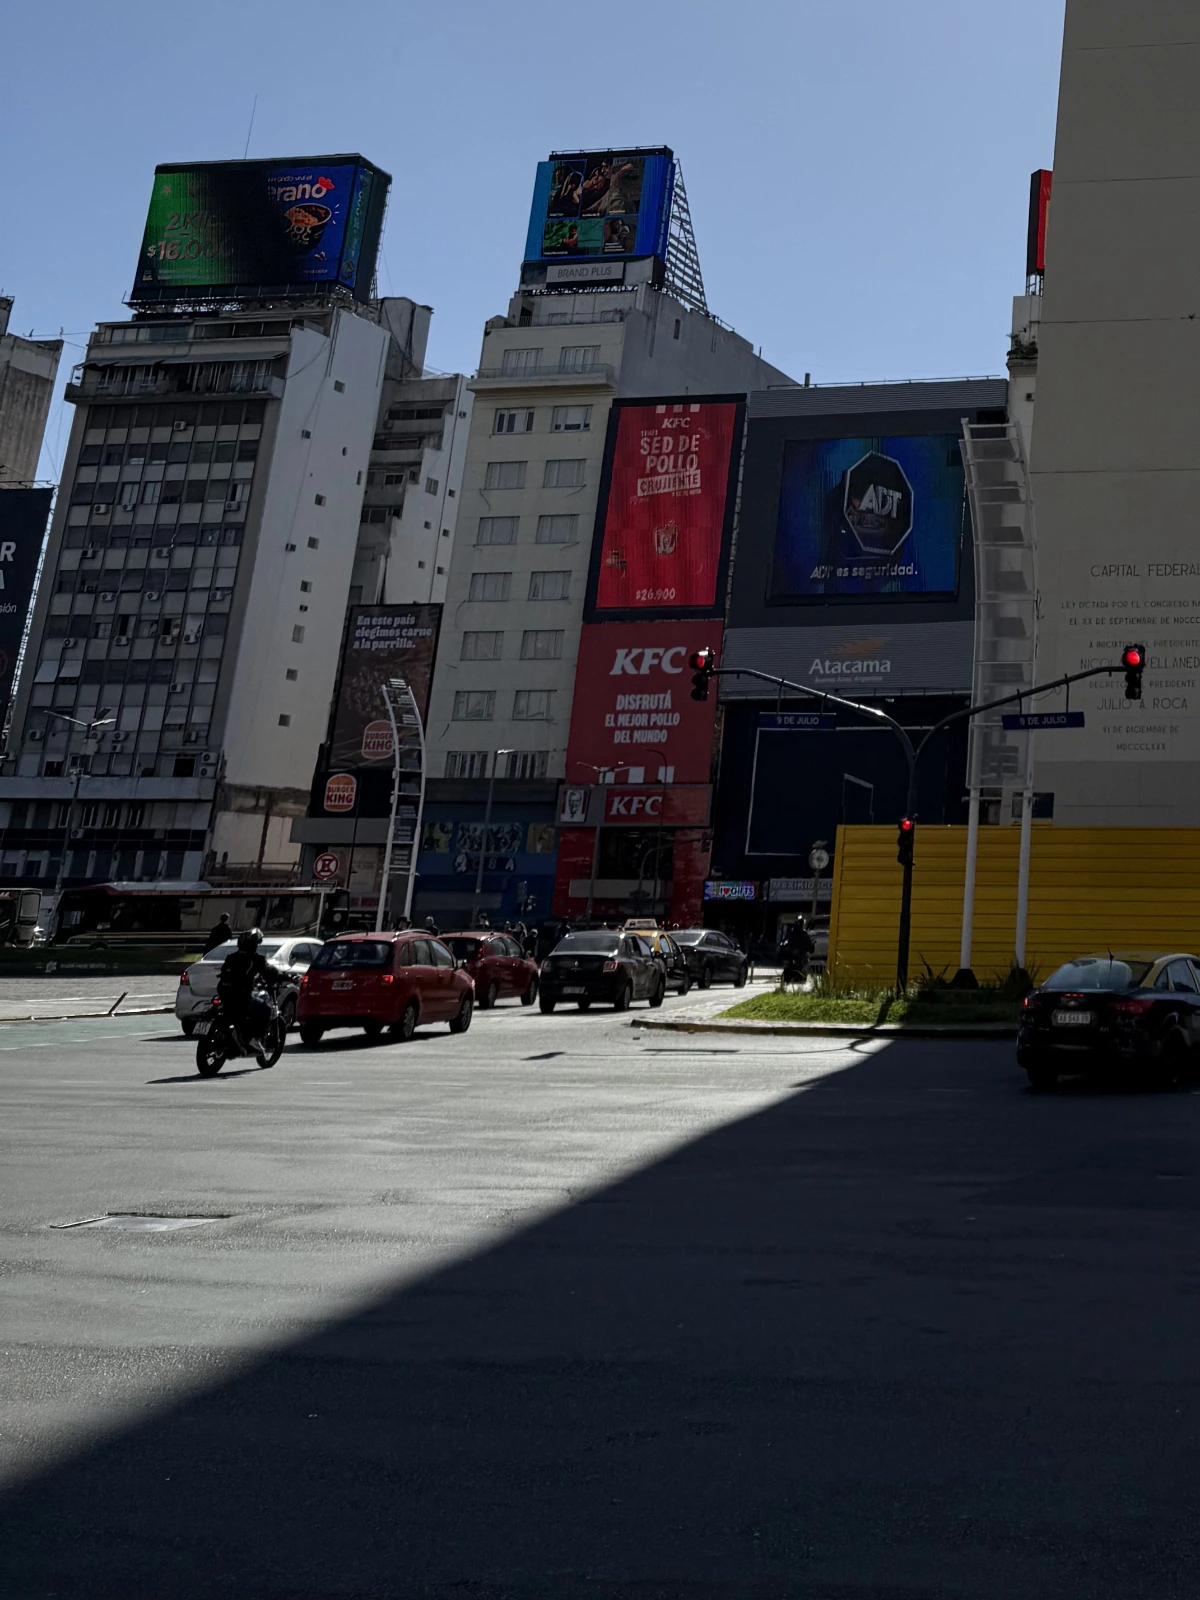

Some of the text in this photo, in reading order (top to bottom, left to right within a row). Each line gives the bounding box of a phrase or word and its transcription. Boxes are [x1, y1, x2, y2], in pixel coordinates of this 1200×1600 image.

[558, 266, 612, 278] BRAND PLUS
[662, 418, 690, 428] KFC
[640, 434, 700, 455] SED DE
[645, 454, 698, 473] POLLO
[639, 472, 700, 494] CRUJIENTE
[859, 484, 902, 519] ADT
[836, 567, 849, 577] es
[852, 563, 918, 579] seguridad.
[1090, 564, 1140, 577] CAPITAL
[636, 588, 675, 600] $26.900
[1079, 601, 1109, 609] DICTADA
[1144, 600, 1189, 608] CONGRESO
[357, 613, 415, 627] En este país
[1109, 617, 1157, 625] SEPTIEMBRE
[1160, 617, 1170, 625] DE
[355, 626, 432, 639] elegimos carne
[361, 638, 371, 649] la
[371, 638, 416, 651] parrilla.
[1153, 640, 1200, 648] PRESIDENTE
[609, 647, 687, 676] KFC
[808, 658, 891, 675] Atacama
[1149, 680, 1196, 688] PRESIDENTE
[615, 690, 672, 711] DISFRUTÁ
[1097, 697, 1188, 710] JULIO A ROCA
[604, 712, 680, 727] EL MEJOR POLLO
[777, 716, 819, 725] 9 DE JULIO
[1027, 717, 1039, 725] DE
[1042, 715, 1067, 724] JULIO
[1112, 726, 1123, 734] DE
[1126, 725, 1167, 734] DICIEMBRE
[1169, 725, 1180, 734] DE
[613, 730, 668, 744] DEL MUNDO
[364, 741, 392, 750] KING
[327, 786, 354, 794] BURGER
[326, 793, 353, 803] KING
[609, 796, 663, 816] KFC
